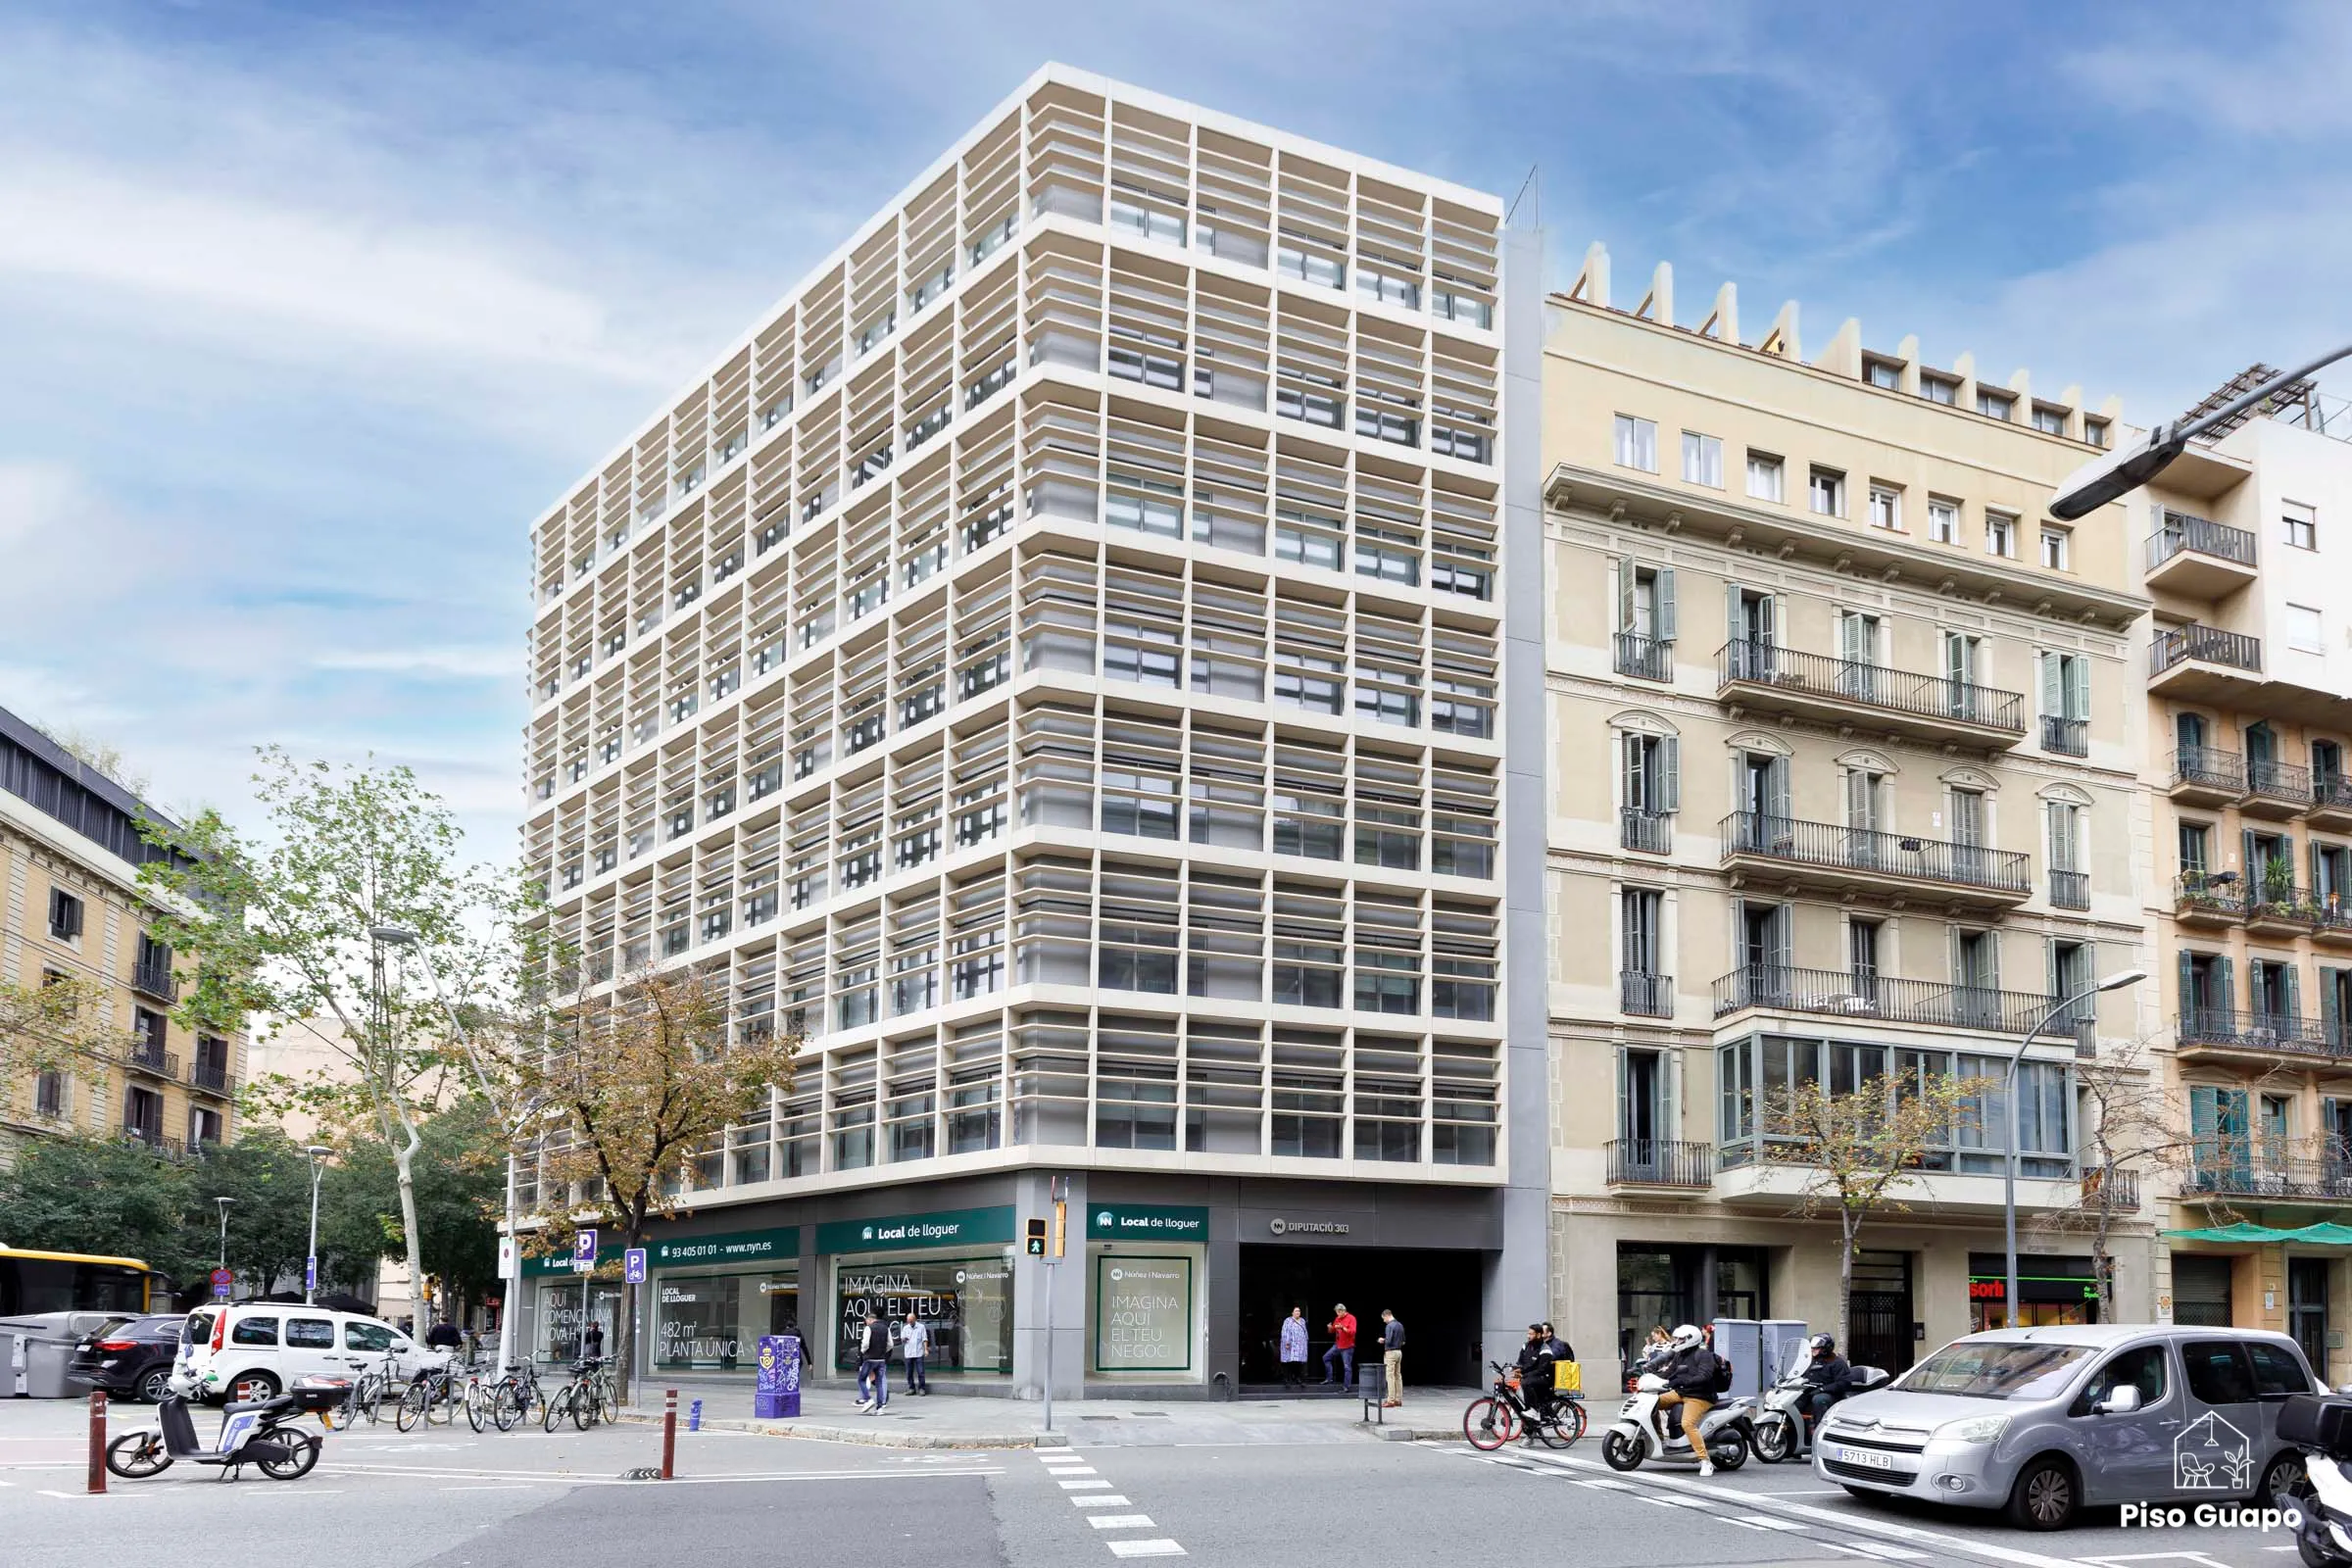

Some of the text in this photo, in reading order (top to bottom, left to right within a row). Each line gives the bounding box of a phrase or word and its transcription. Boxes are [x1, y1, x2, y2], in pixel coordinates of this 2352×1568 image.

[1120, 1217, 1200, 1230] Local de lloguer
[1288, 1221, 1349, 1233] DIPUTACIÓ 303
[878, 1224, 959, 1240] Local de lloguer
[578, 1235, 592, 1258] P
[671, 1248, 681, 1258] 93
[682, 1247, 697, 1257] 405
[698, 1245, 708, 1256] 01
[708, 1245, 717, 1255] 01
[725, 1241, 772, 1255] www.nyn.es
[552, 1257, 568, 1268] Local
[630, 1254, 640, 1268] P
[845, 1274, 911, 1295] IMAGINA
[670, 1294, 696, 1302] LLOGUER
[1112, 1296, 1178, 1310] IMAGINA
[888, 1298, 906, 1316] EL
[907, 1296, 941, 1316] TEU
[661, 1321, 680, 1338] 482
[1111, 1329, 1162, 1342] EL TEU
[660, 1336, 745, 1357] PLANTA ÚNICA
[1111, 1345, 1170, 1358] NEGOCI
[1844, 1450, 1888, 1467] 5713 HLB
